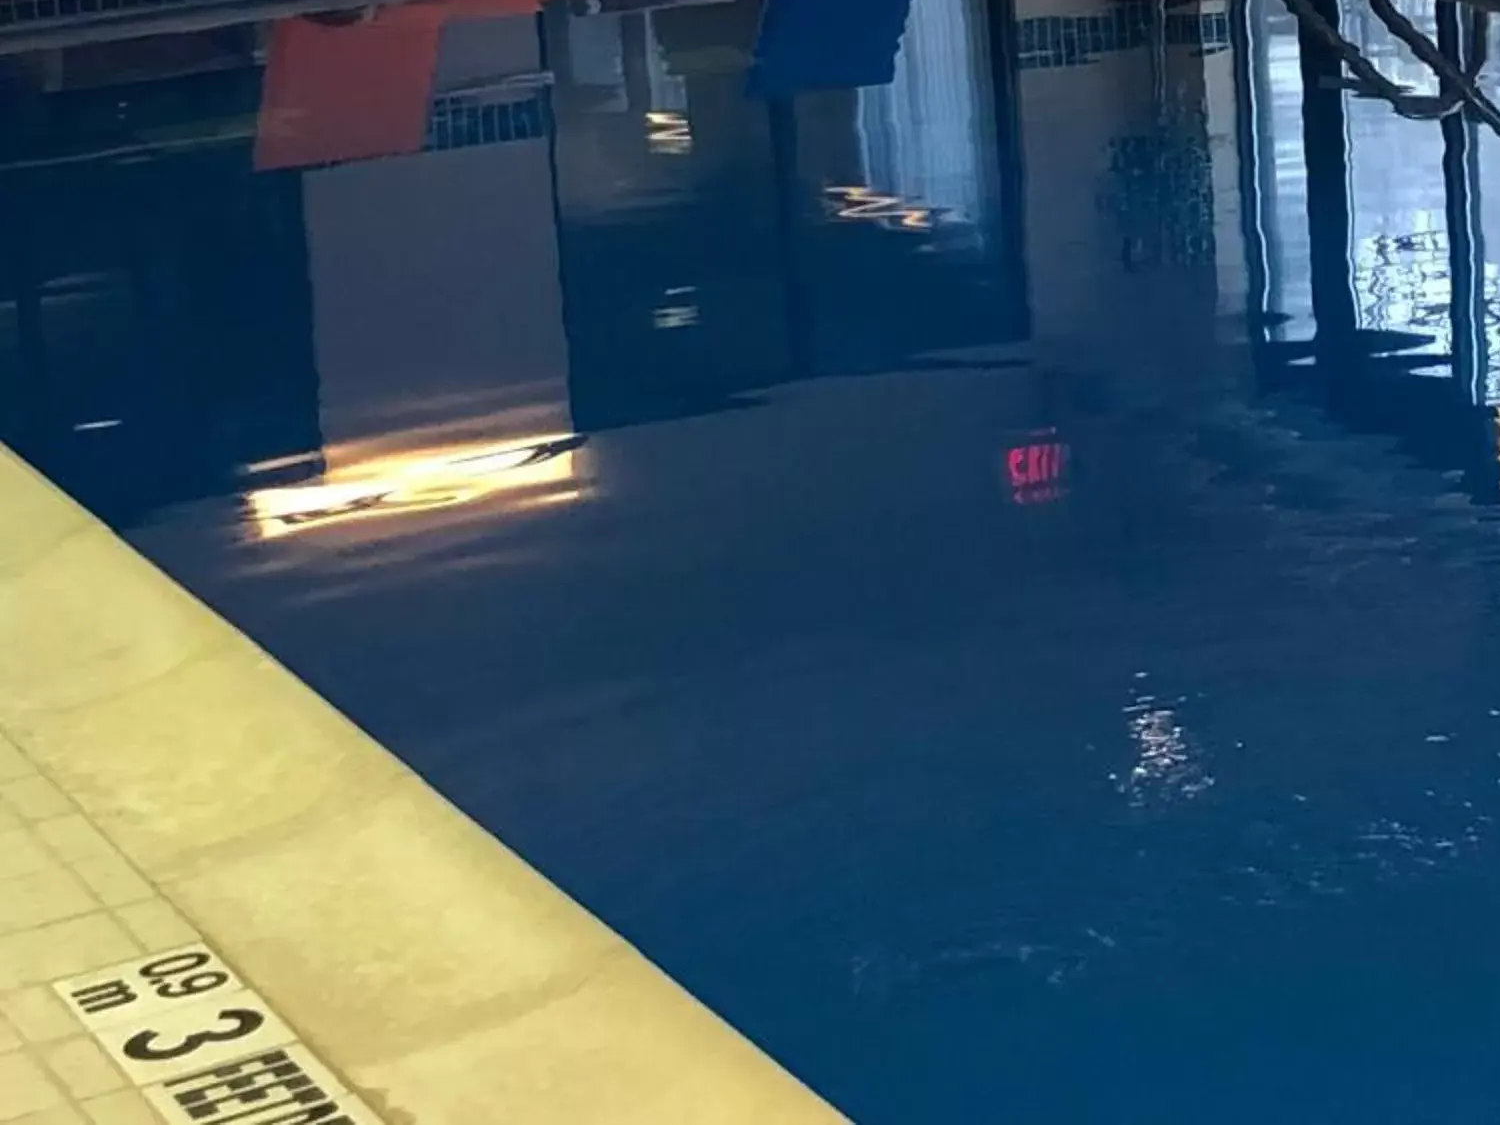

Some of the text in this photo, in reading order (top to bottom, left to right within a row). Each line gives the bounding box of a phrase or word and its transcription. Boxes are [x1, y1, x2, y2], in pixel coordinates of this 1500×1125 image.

[70, 978, 138, 1015] m
[138, 951, 230, 1000] 0.9
[123, 1007, 265, 1062] 3
[163, 1048, 328, 1125] FEET
